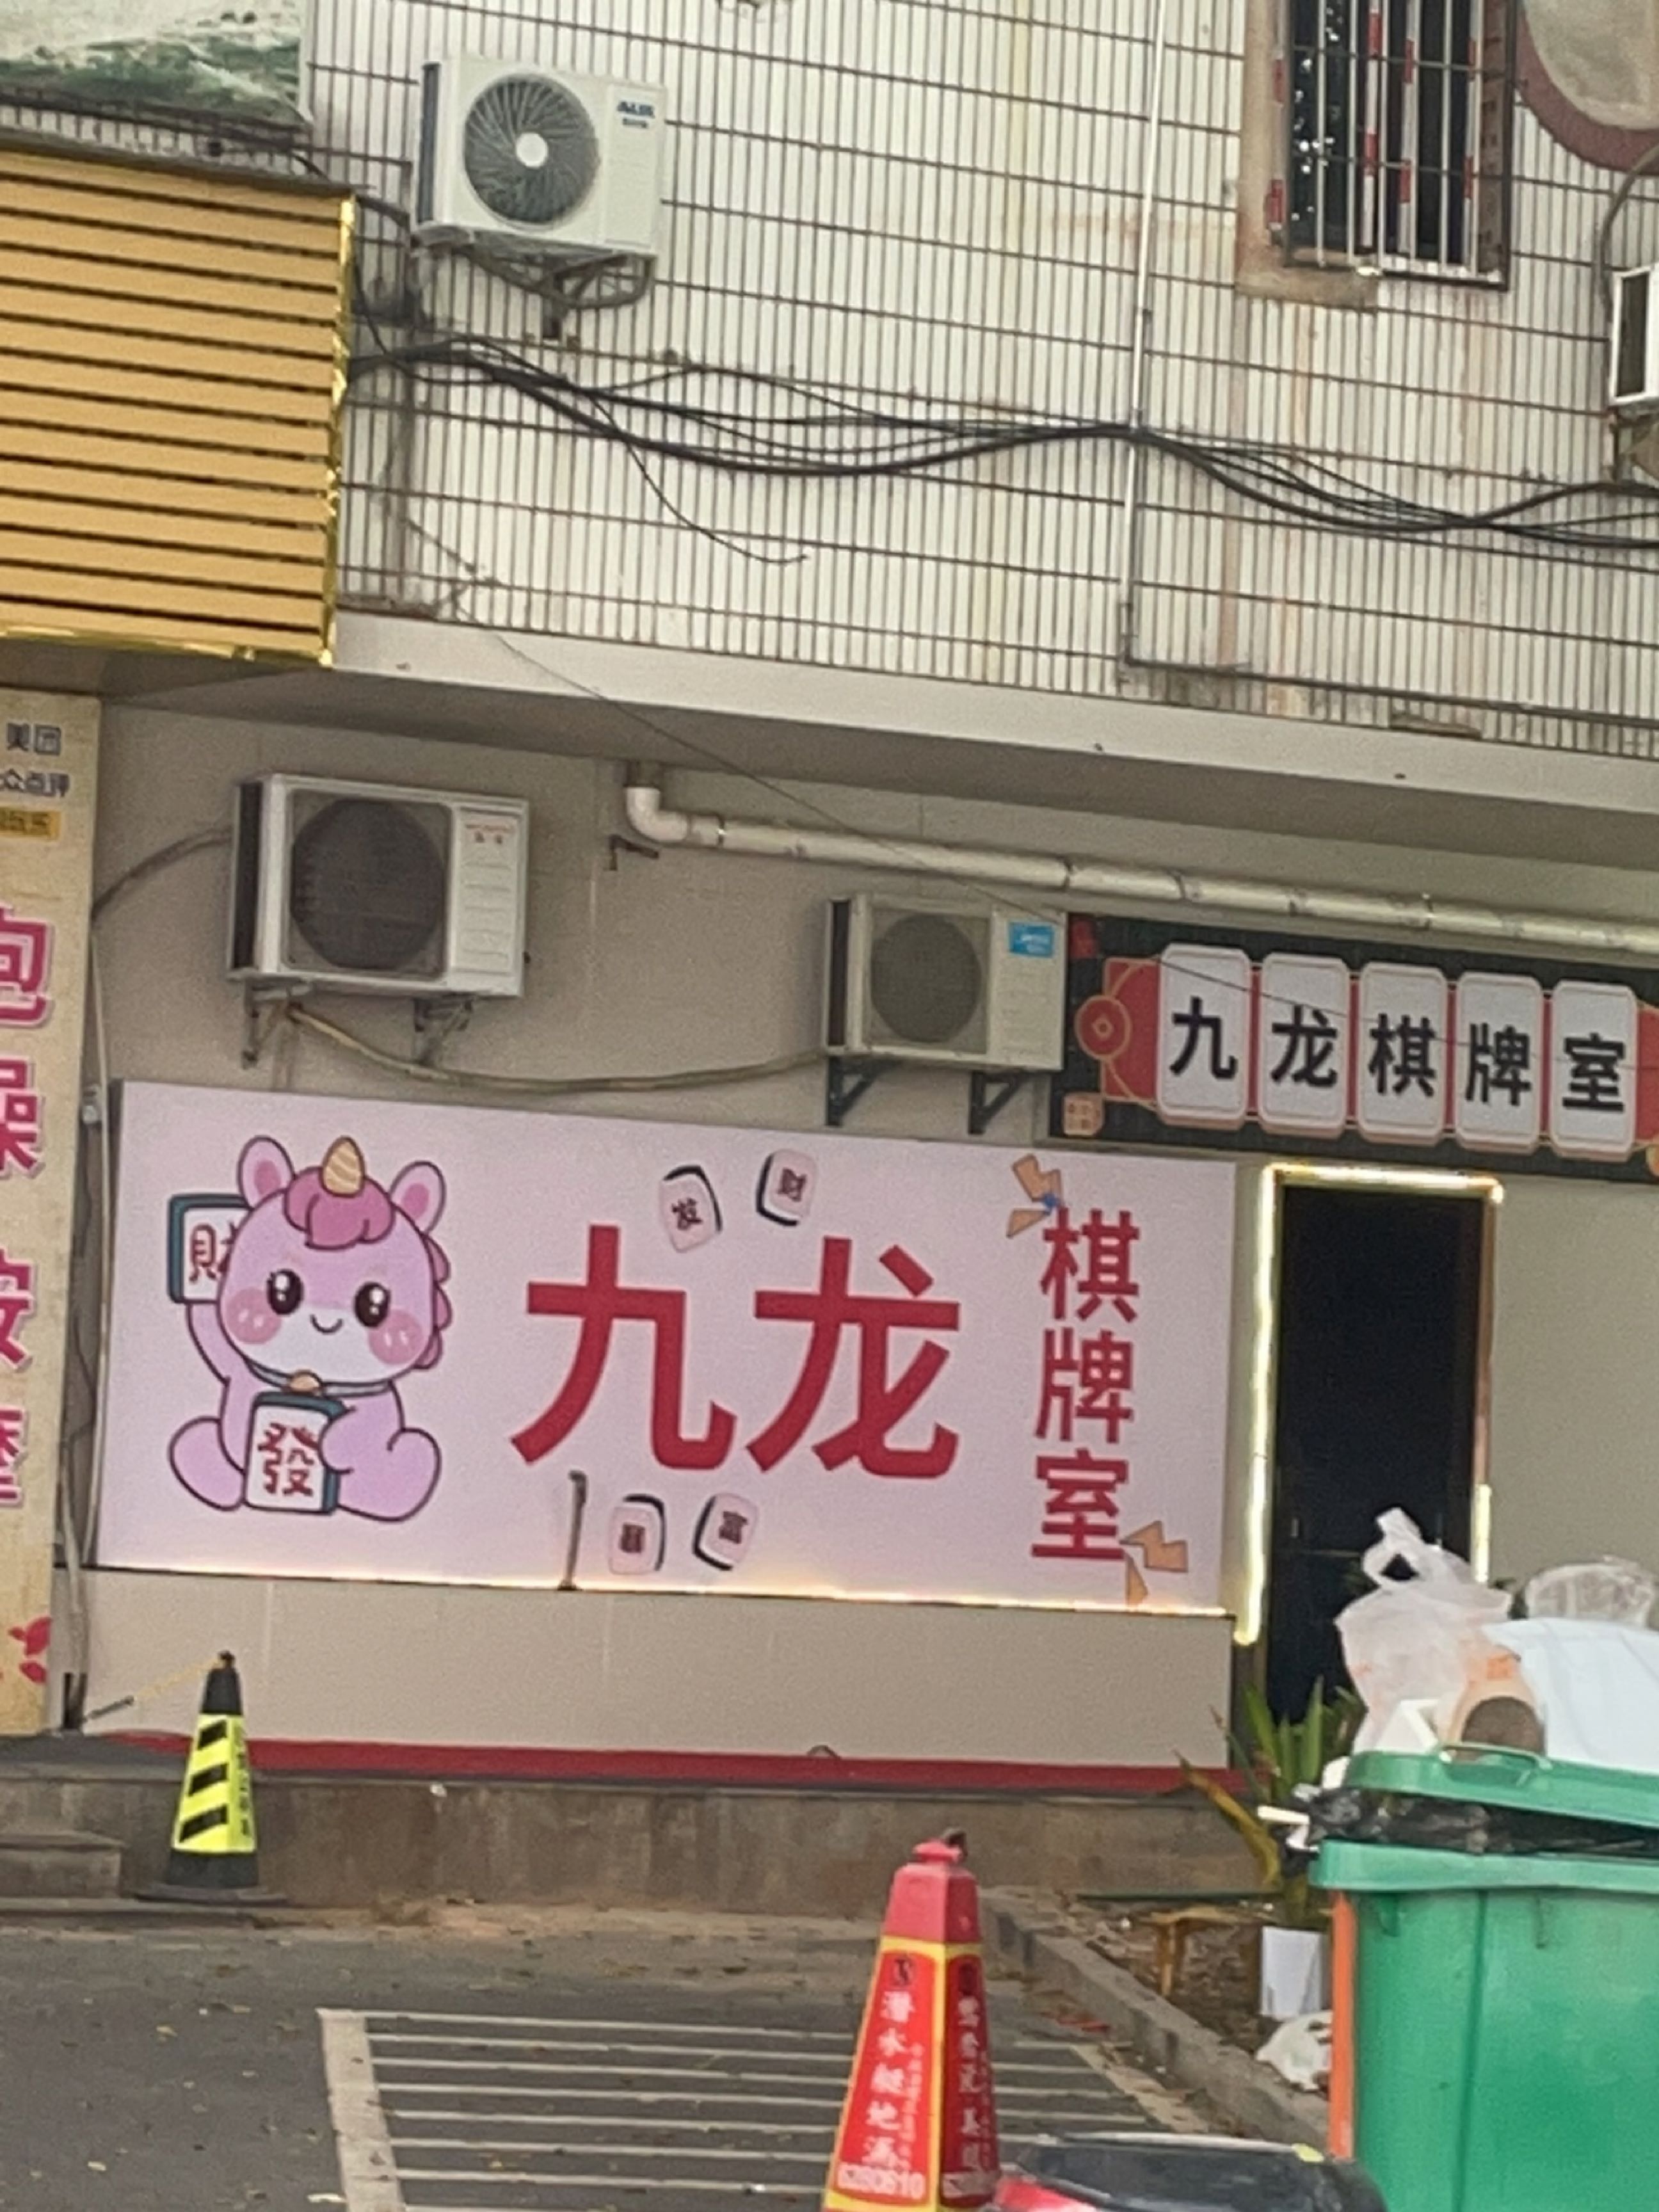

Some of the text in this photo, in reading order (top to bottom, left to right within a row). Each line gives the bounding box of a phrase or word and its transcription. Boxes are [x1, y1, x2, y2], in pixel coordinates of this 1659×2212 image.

[6, 722, 62, 757] 美团
[1169, 995, 1626, 1114] 九龙棋牌室
[511, 1223, 961, 1480] 九龙
[1032, 1208, 1140, 1561] 棋牌室
[259, 1422, 319, 1496] 發
